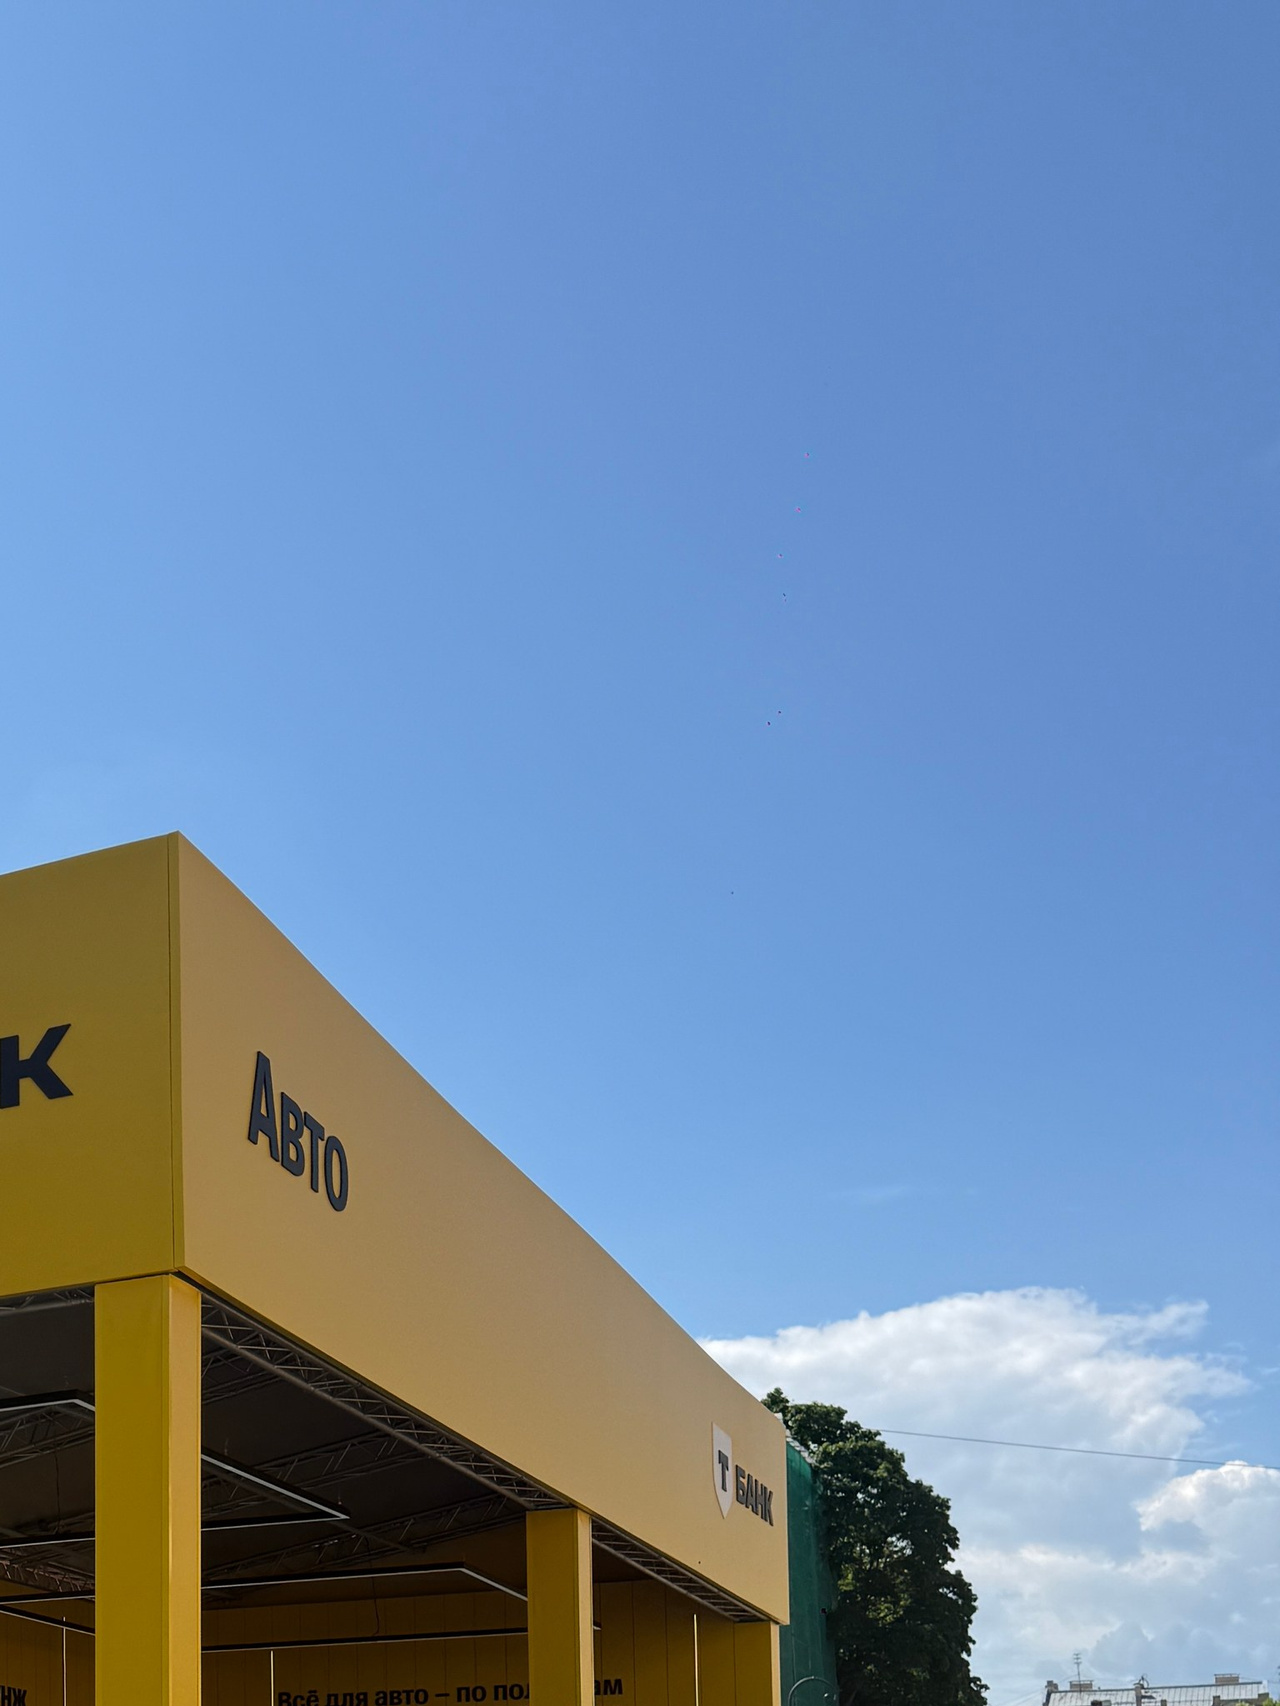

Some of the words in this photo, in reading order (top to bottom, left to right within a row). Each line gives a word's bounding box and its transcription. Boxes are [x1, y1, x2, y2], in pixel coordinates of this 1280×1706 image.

[735, 1464, 774, 1527] БАНК
[375, 1688, 429, 1706] авто
[456, 1685, 487, 1703] по
